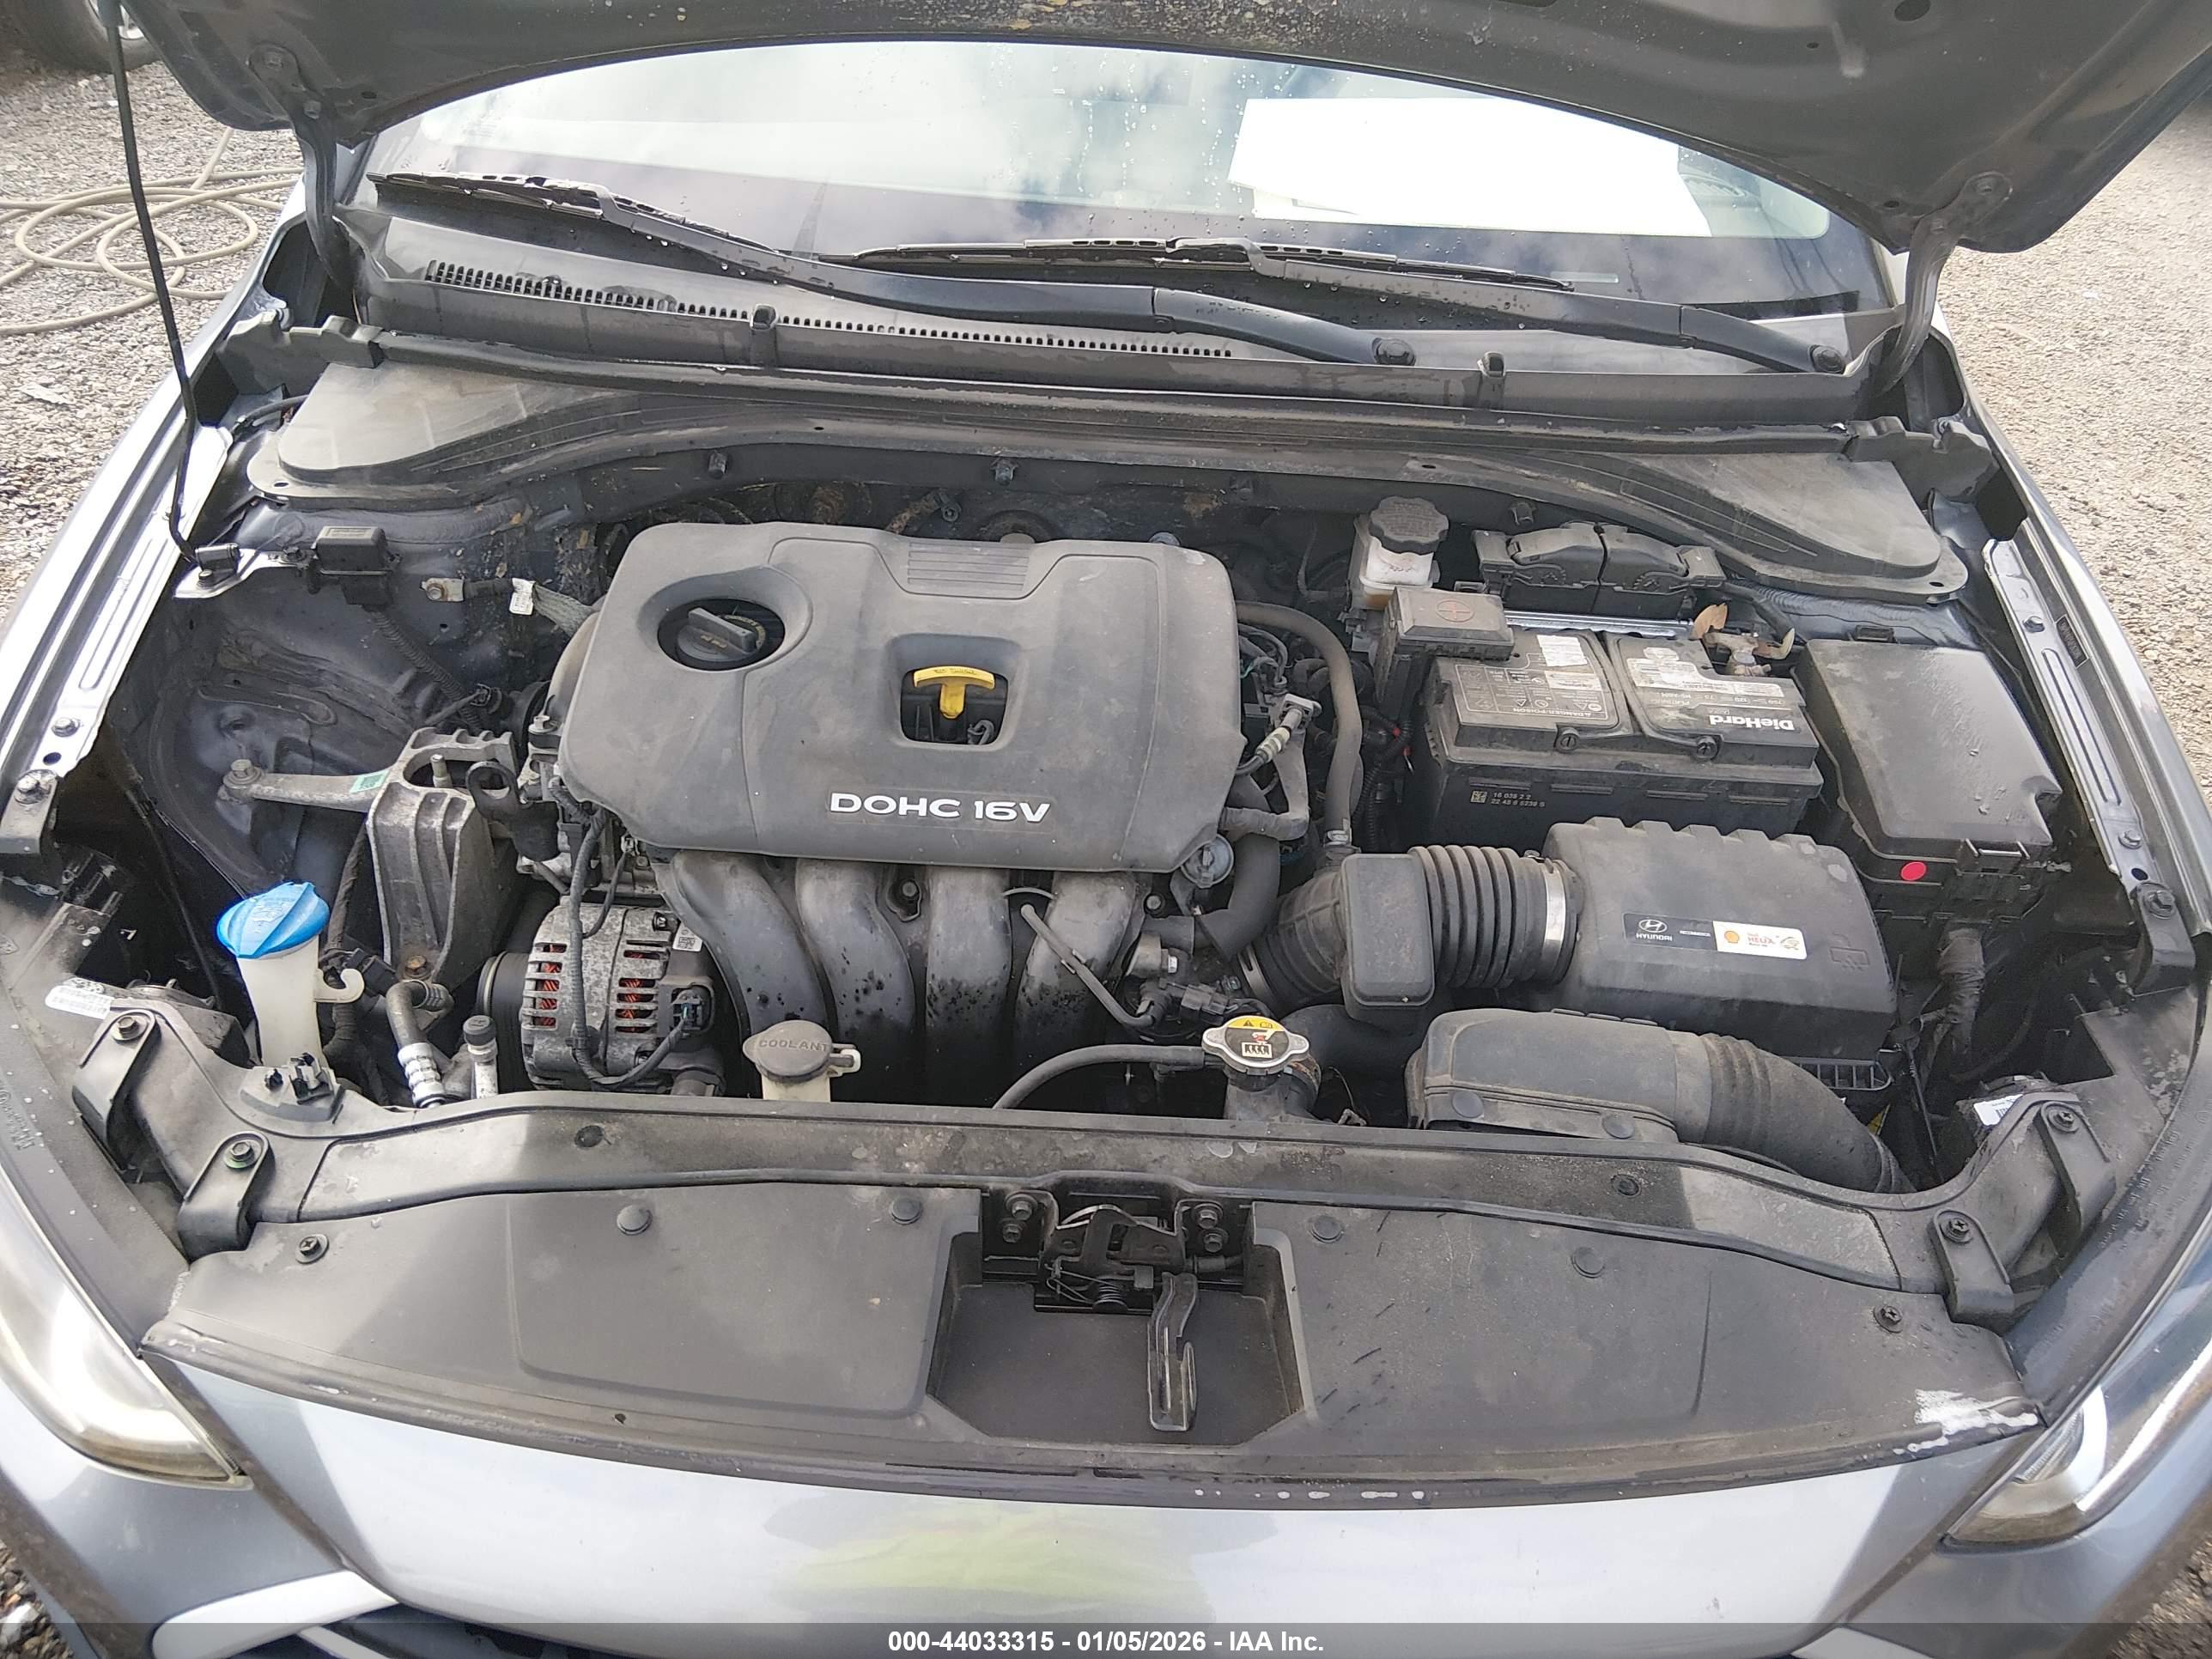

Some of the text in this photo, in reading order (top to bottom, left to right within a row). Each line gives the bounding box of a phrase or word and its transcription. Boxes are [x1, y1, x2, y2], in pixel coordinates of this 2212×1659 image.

[1709, 714, 1795, 731] DieHard
[830, 793, 1050, 823] DOHC 16V
[1636, 933, 1673, 942] HYUNDAI
[759, 1039, 828, 1052] COOLANT
